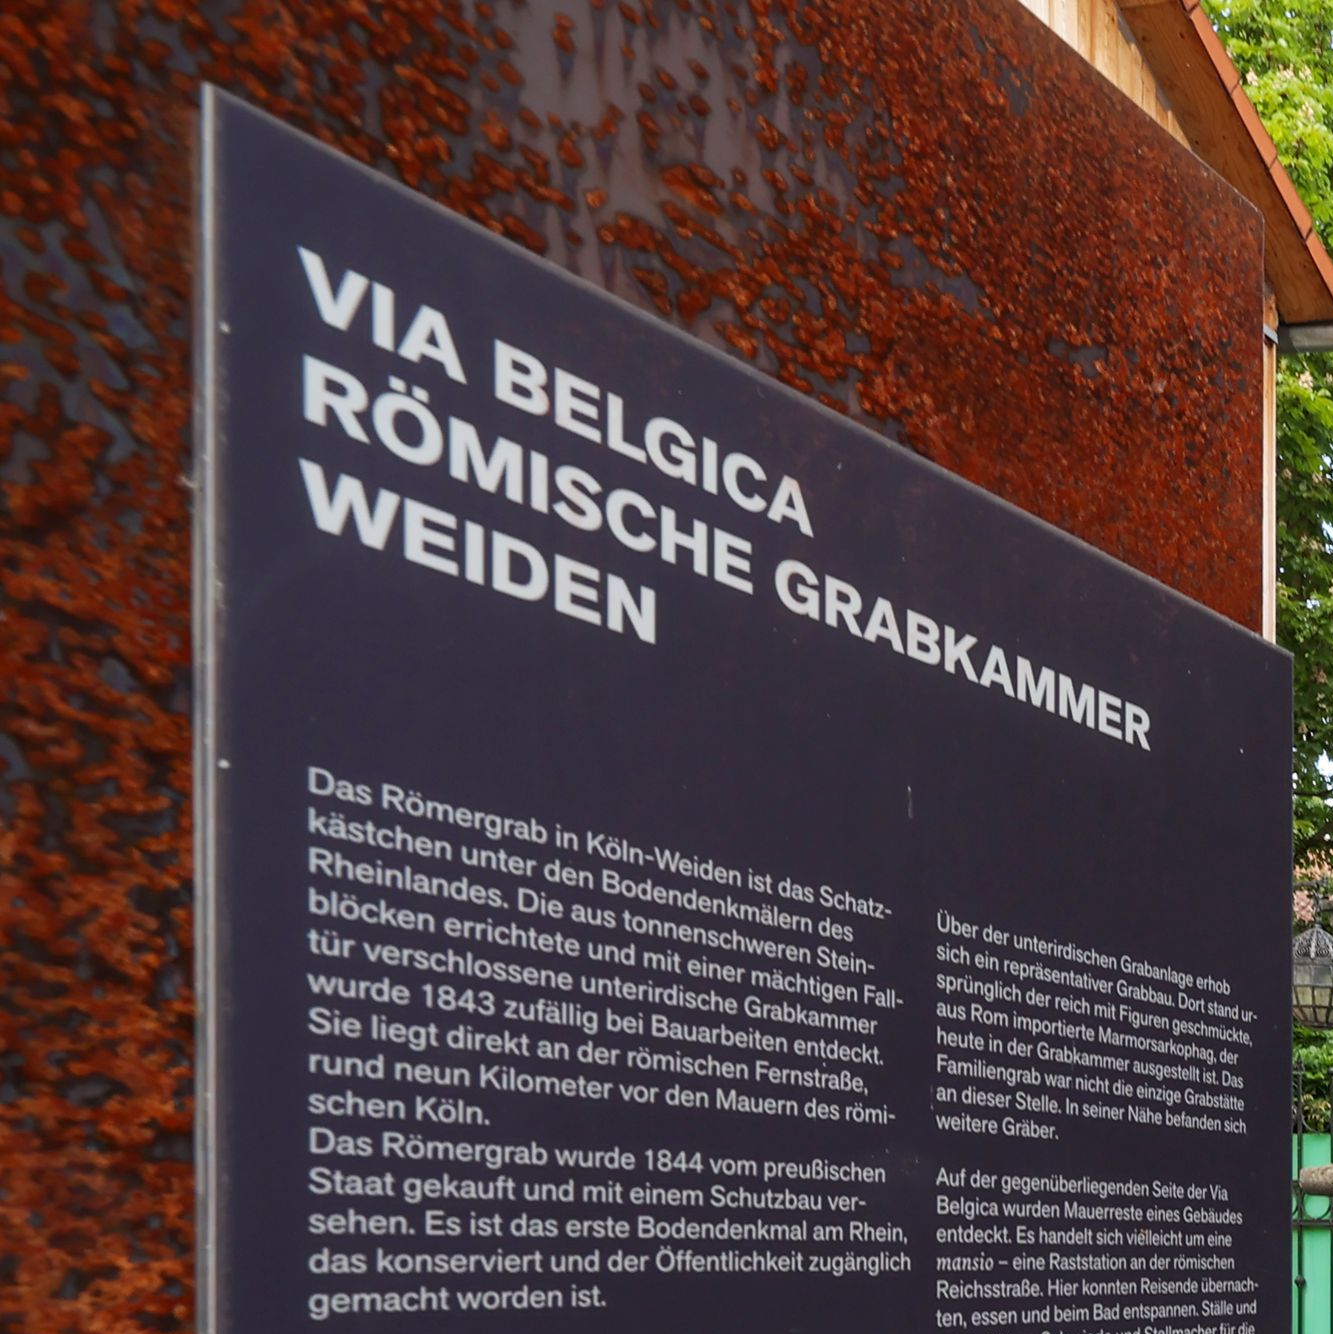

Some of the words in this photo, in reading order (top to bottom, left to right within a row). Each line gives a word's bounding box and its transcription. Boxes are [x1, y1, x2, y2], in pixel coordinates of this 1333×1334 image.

[297, 246, 467, 385] VIA
[493, 338, 815, 538] BELGICA
[298, 457, 657, 646] WEIDEN
[302, 354, 755, 595] RÖMISCHE
[773, 558, 1152, 752] GRABKAMMER
[308, 766, 373, 806] Das
[381, 783, 548, 845] Römergrab
[555, 823, 579, 851] in
[587, 831, 742, 888] Köln-Weiden
[748, 867, 773, 895] ist
[777, 877, 815, 904] das
[819, 884, 893, 920] Schatz-
[308, 806, 452, 861] kästchen
[461, 845, 537, 877] unter
[543, 859, 594, 890] den
[601, 868, 813, 934] Bodendenkmälern
[817, 916, 854, 943] des
[307, 928, 356, 958] tür
[362, 942, 573, 991] verschlossene
[580, 975, 738, 1015] unterirdische
[743, 995, 878, 1035] Grabkammer
[937, 908, 980, 939] Über
[982, 924, 1010, 946] der
[1013, 934, 1118, 971] unterirdischen
[1120, 954, 1194, 990] Grabanlage
[1196, 975, 1231, 996] erhob
[307, 1006, 363, 1039] Sie
[371, 1014, 439, 1052] liegt
[446, 1024, 531, 1057] direkt
[536, 1040, 570, 1061] an
[576, 1040, 621, 1066] der
[627, 1046, 749, 1080] römischen
[755, 1059, 869, 1096] Fernstraße,
[936, 973, 1022, 1003] sprünglich
[1025, 987, 1052, 1008] der
[1054, 994, 1091, 1016] reich
[1094, 1001, 1116, 1021] mit
[1119, 1004, 1170, 1030] Figuren
[1172, 1018, 1253, 1048] geschmückte,
[936, 1001, 967, 1021] aus
[970, 1002, 1009, 1028] Rom
[1013, 1010, 1095, 1042] importierte
[1098, 1025, 1217, 1065] Marmorsarkophag,
[1219, 1047, 1239, 1065] der
[309, 1126, 373, 1157] Das
[382, 1131, 548, 1170] Römergrab
[554, 1146, 636, 1171] wurde
[644, 1148, 704, 1174] 1844
[708, 1158, 758, 1177] vom
[763, 1158, 886, 1183] preußischen
[935, 1112, 999, 1135] weitere
[1002, 1116, 1059, 1140] Gräber.
[935, 1167, 966, 1188] Auf
[969, 1169, 998, 1189] der
[1001, 1174, 1150, 1199] gegenüberliegenden
[1151, 1180, 1185, 1199] Seite
[1186, 1183, 1208, 1200] der
[1209, 1183, 1229, 1201] Via
[936, 1194, 999, 1221] Belgica
[1002, 1199, 1060, 1218] wurden
[1064, 1200, 1144, 1222] Mauerreste
[1146, 1204, 1181, 1223] eines
[1182, 1205, 1243, 1225] Gebäudes
[308, 1247, 368, 1274] das
[376, 1248, 543, 1274] konserviert
[550, 1249, 600, 1273] und
[607, 1249, 650, 1273] der
[655, 1245, 804, 1273] Öffentlichkeit
[808, 1251, 912, 1277] zugänglich
[936, 1278, 1044, 1300] Reichsstraße.
[1047, 1278, 1079, 1297] Hier
[1082, 1279, 1138, 1296] konnten
[1140, 1277, 1199, 1295] Reisende
[1201, 1276, 1259, 1293] übernach-
